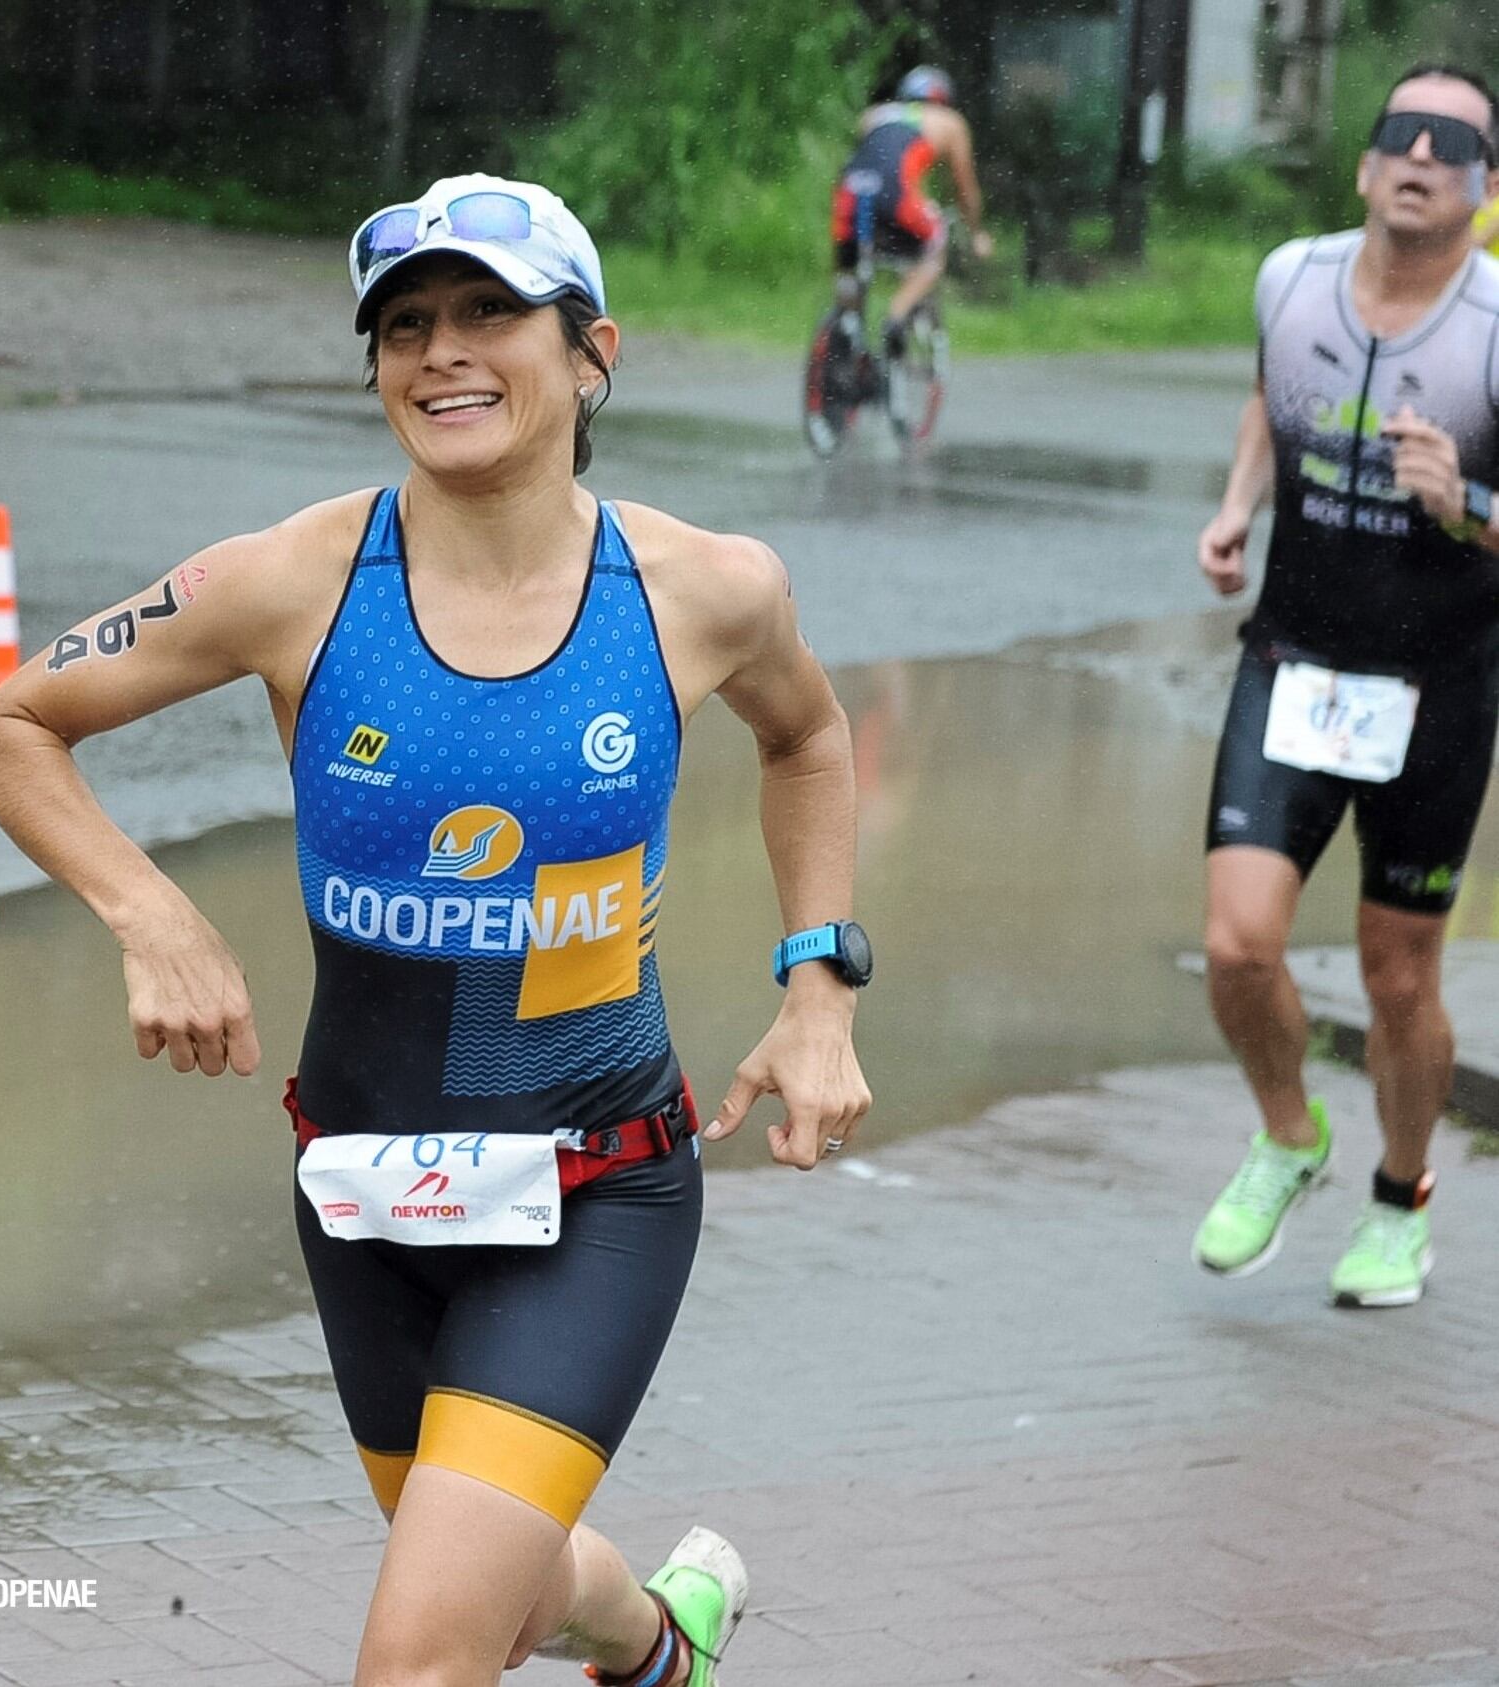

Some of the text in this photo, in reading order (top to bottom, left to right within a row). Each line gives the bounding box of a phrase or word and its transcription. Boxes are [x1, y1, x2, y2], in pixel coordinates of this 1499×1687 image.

[47, 579, 179, 670] 764
[349, 731, 384, 758] IN
[327, 762, 396, 788] INVERSE
[581, 774, 638, 794] GARNIER
[324, 876, 623, 950] COOPENAE
